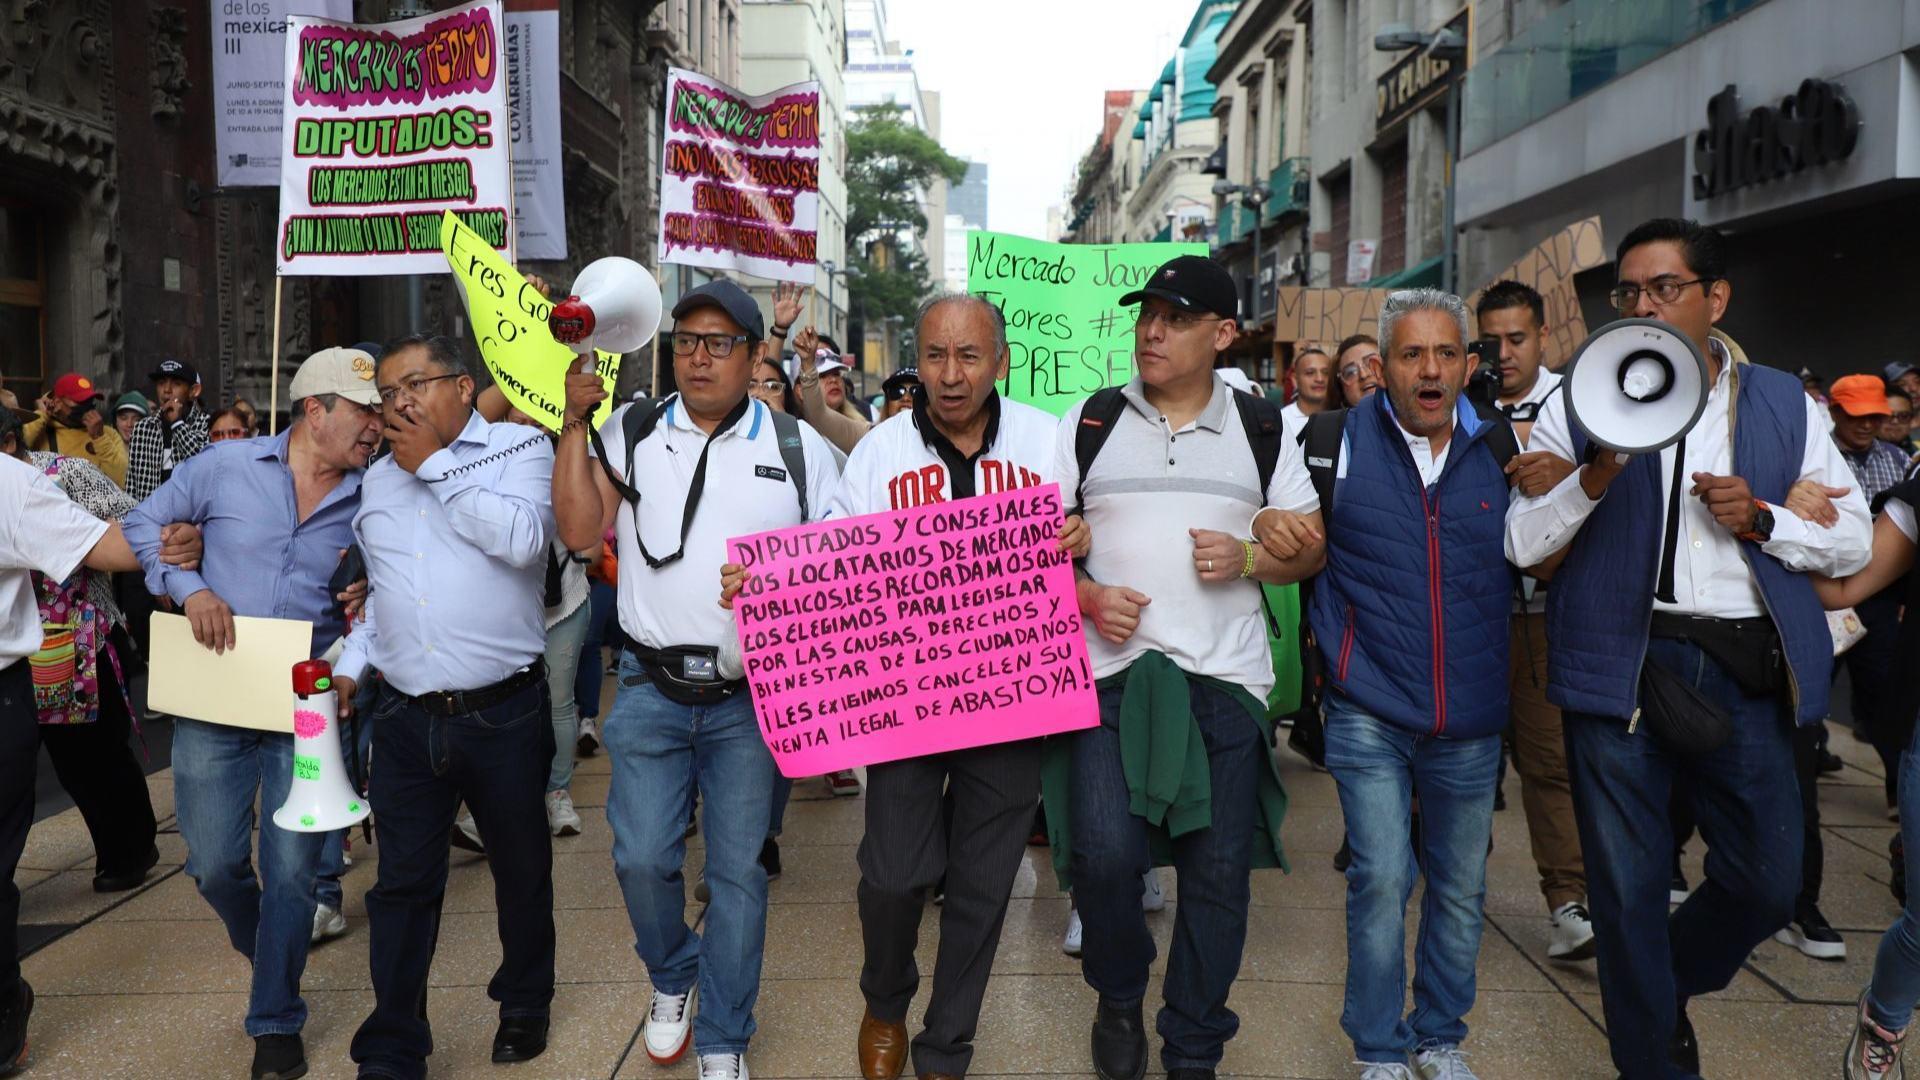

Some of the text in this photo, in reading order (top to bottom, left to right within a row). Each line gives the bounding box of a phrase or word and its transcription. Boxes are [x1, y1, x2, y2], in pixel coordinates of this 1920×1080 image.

[224, 17, 287, 34] mexica
[226, 81, 285, 89] JUNIO-SEPTIE
[299, 38, 401, 99] MERCADO
[425, 20, 492, 87] TEPITO
[507, 23, 521, 143] COVARRUBIAS
[259, 99, 284, 107] DOMIN
[674, 88, 752, 136] MERCADO
[296, 108, 490, 155] DIPUTADOS:
[312, 161, 474, 204] LOS MERCADOS ESTAN EN RIESGO,
[325, 217, 364, 252] AYUDAR
[372, 216, 395, 251] VAN
[450, 223, 505, 298] Eres
[970, 236, 1076, 285] Mercado
[1277, 287, 1379, 341] MERCA
[734, 494, 1058, 568] DIPUTADOS Y CONSEJALES
[788, 545, 934, 587] LOCATARIOS
[940, 539, 967, 563] DE
[885, 551, 1035, 600] RECORDAMOS
[1037, 548, 1069, 569] QUE
[744, 574, 1048, 653] LOS ELEGIMOS PARA LEGISLAR
[747, 596, 1061, 677] POR LAS CAUSAS, DERECHOS Y
[754, 614, 1080, 699] BIENESTAR DE LOS CIUDADANOS
[818, 679, 908, 715] EXIGIMOS
[918, 651, 1031, 691] CANCELEN
[1040, 642, 1072, 666] SU
[771, 727, 829, 754] VENTA
[839, 709, 904, 741] ILEGAL
[915, 700, 942, 721] DE
